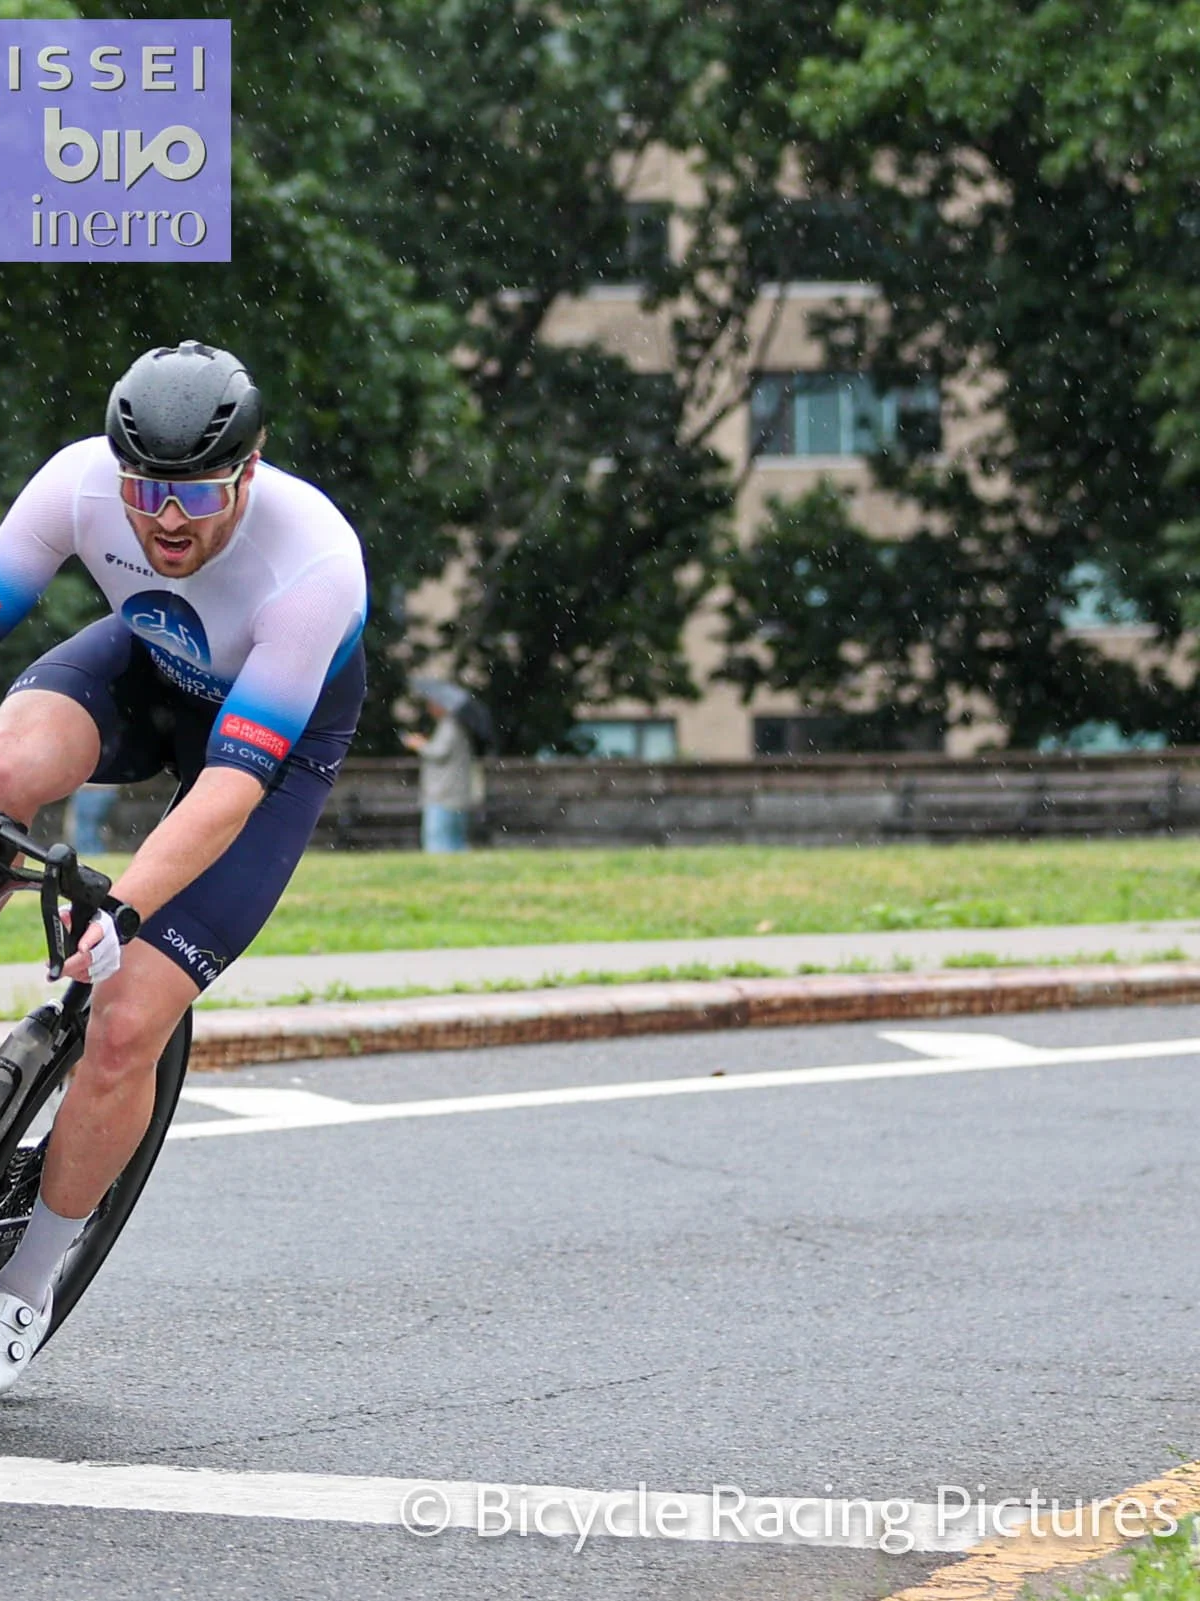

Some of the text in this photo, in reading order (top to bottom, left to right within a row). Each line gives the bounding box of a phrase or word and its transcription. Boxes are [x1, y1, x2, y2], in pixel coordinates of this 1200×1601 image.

[116, 558, 154, 578] PISSEI
[221, 742, 275, 772] JS CYCLE
